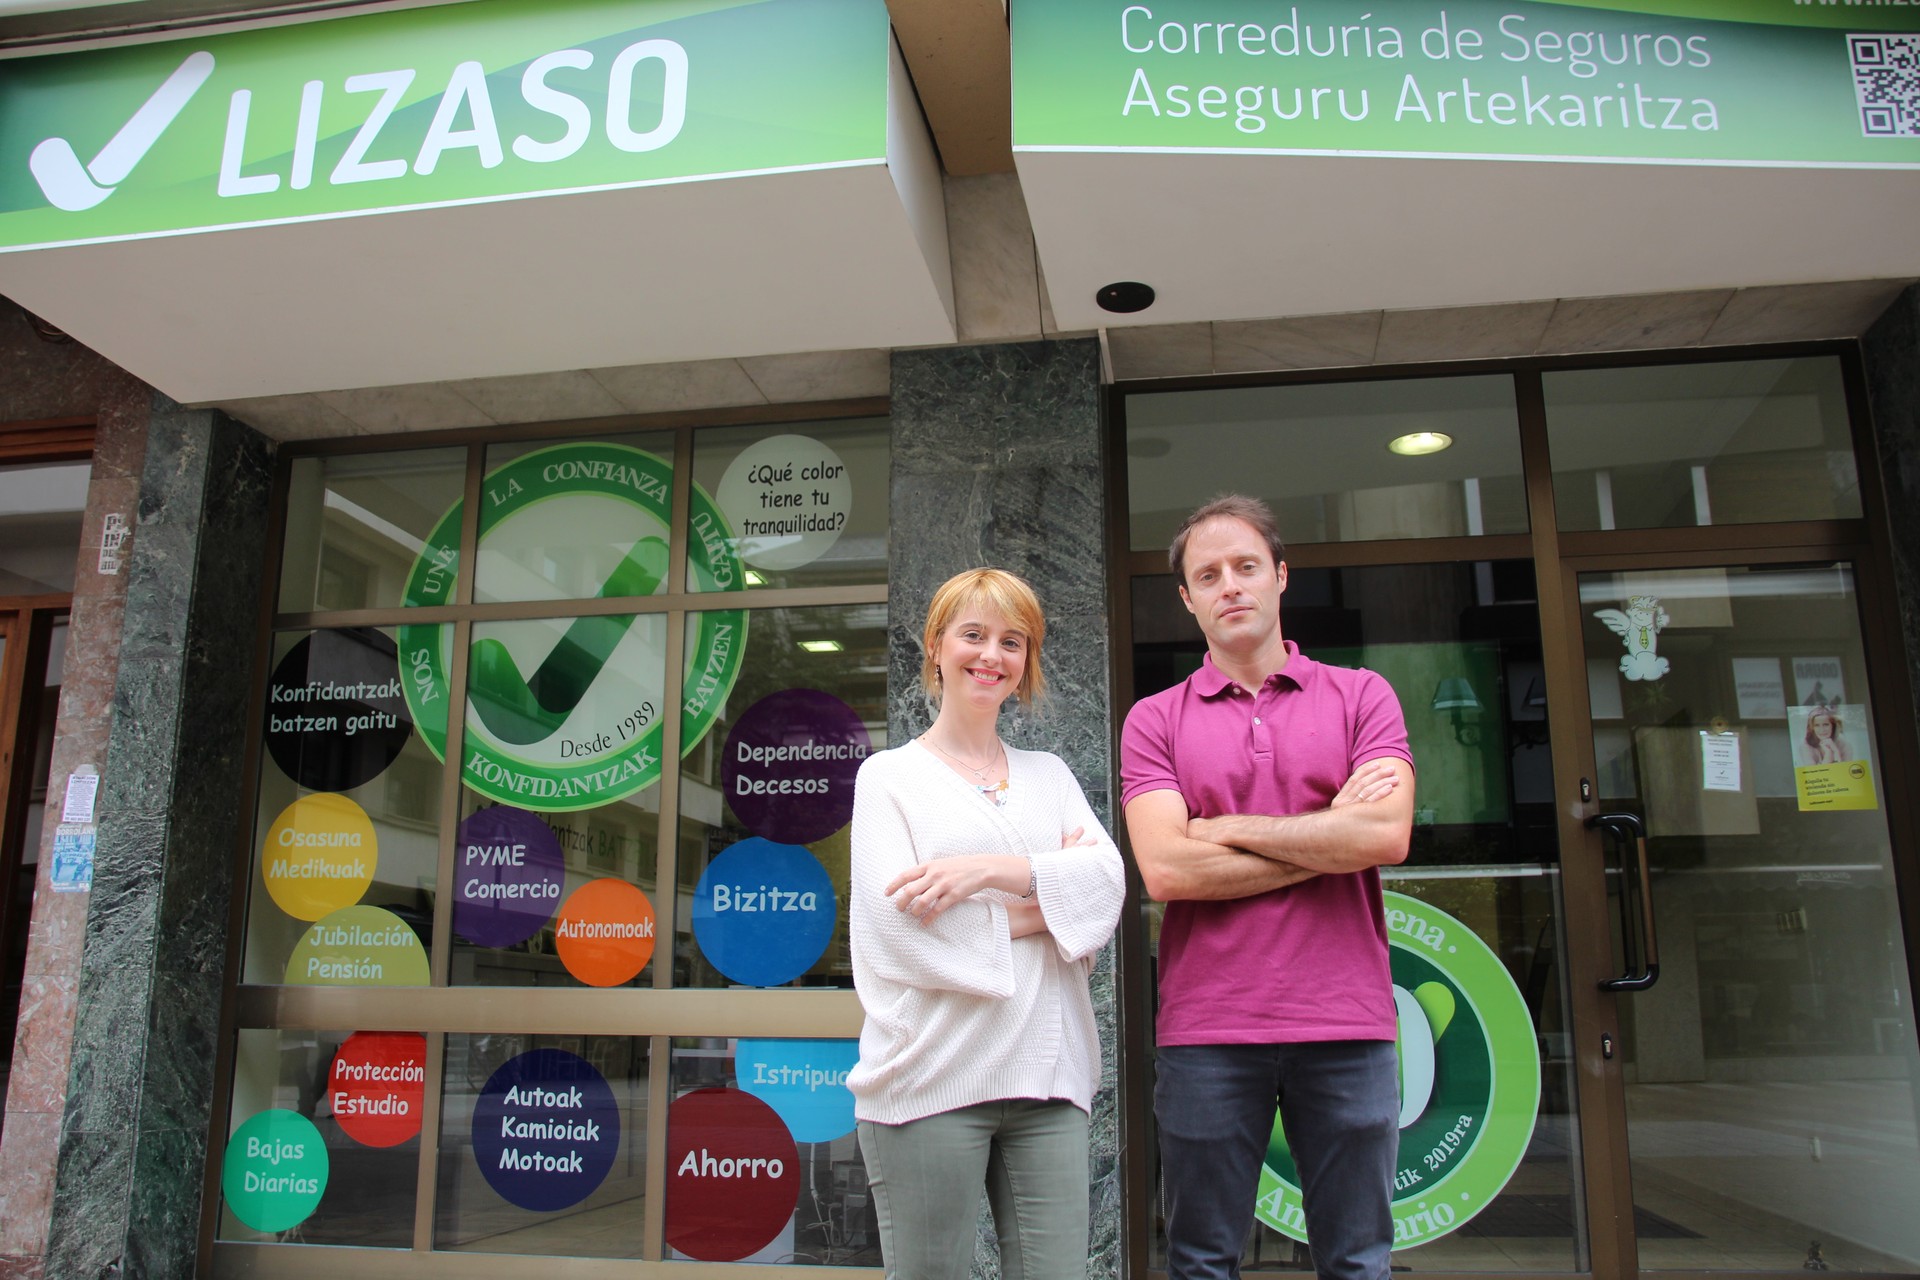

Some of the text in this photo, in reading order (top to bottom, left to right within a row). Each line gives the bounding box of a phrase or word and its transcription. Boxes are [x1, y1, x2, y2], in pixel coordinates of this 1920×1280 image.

[1120, 5, 1712, 78] Correduría de Seguros
[1122, 67, 1720, 133] Aseguru Artekaritza
[217, 39, 689, 198] LIZASO
[748, 460, 844, 486] ¿Qué color
[760, 489, 829, 508] tiene tu
[422, 544, 456, 594] UNE
[488, 477, 524, 507] LA
[543, 460, 668, 505] CONFIANZA
[743, 511, 845, 537] tranquilidad?
[466, 512, 733, 798] KONFIDANTZAK BATZEN GAITU
[271, 679, 401, 704] Konfidantzak
[269, 708, 397, 737] batzen gaitu
[560, 700, 655, 758] Desde 1989
[736, 739, 867, 766] Dependencia
[735, 775, 830, 796] Decesos
[278, 828, 361, 849] Osasuna
[466, 844, 526, 866] PYME
[270, 857, 366, 880] Medikuak
[464, 878, 561, 900] Comercio
[712, 884, 818, 914] Bizitza
[310, 924, 415, 948] Jubilación
[556, 917, 654, 939] Autonomoak
[307, 956, 384, 981] Pensión
[334, 1058, 425, 1083] Protección
[333, 1092, 409, 1116] Estudio
[503, 1085, 583, 1108] Autoak
[501, 1116, 600, 1142] Kamioiak
[246, 1137, 305, 1163] Bajas
[1423, 1114, 1473, 1172] 2019ra
[499, 1148, 583, 1174] Motoak
[677, 1148, 784, 1179] Ahorro
[243, 1171, 319, 1195] Diarias
